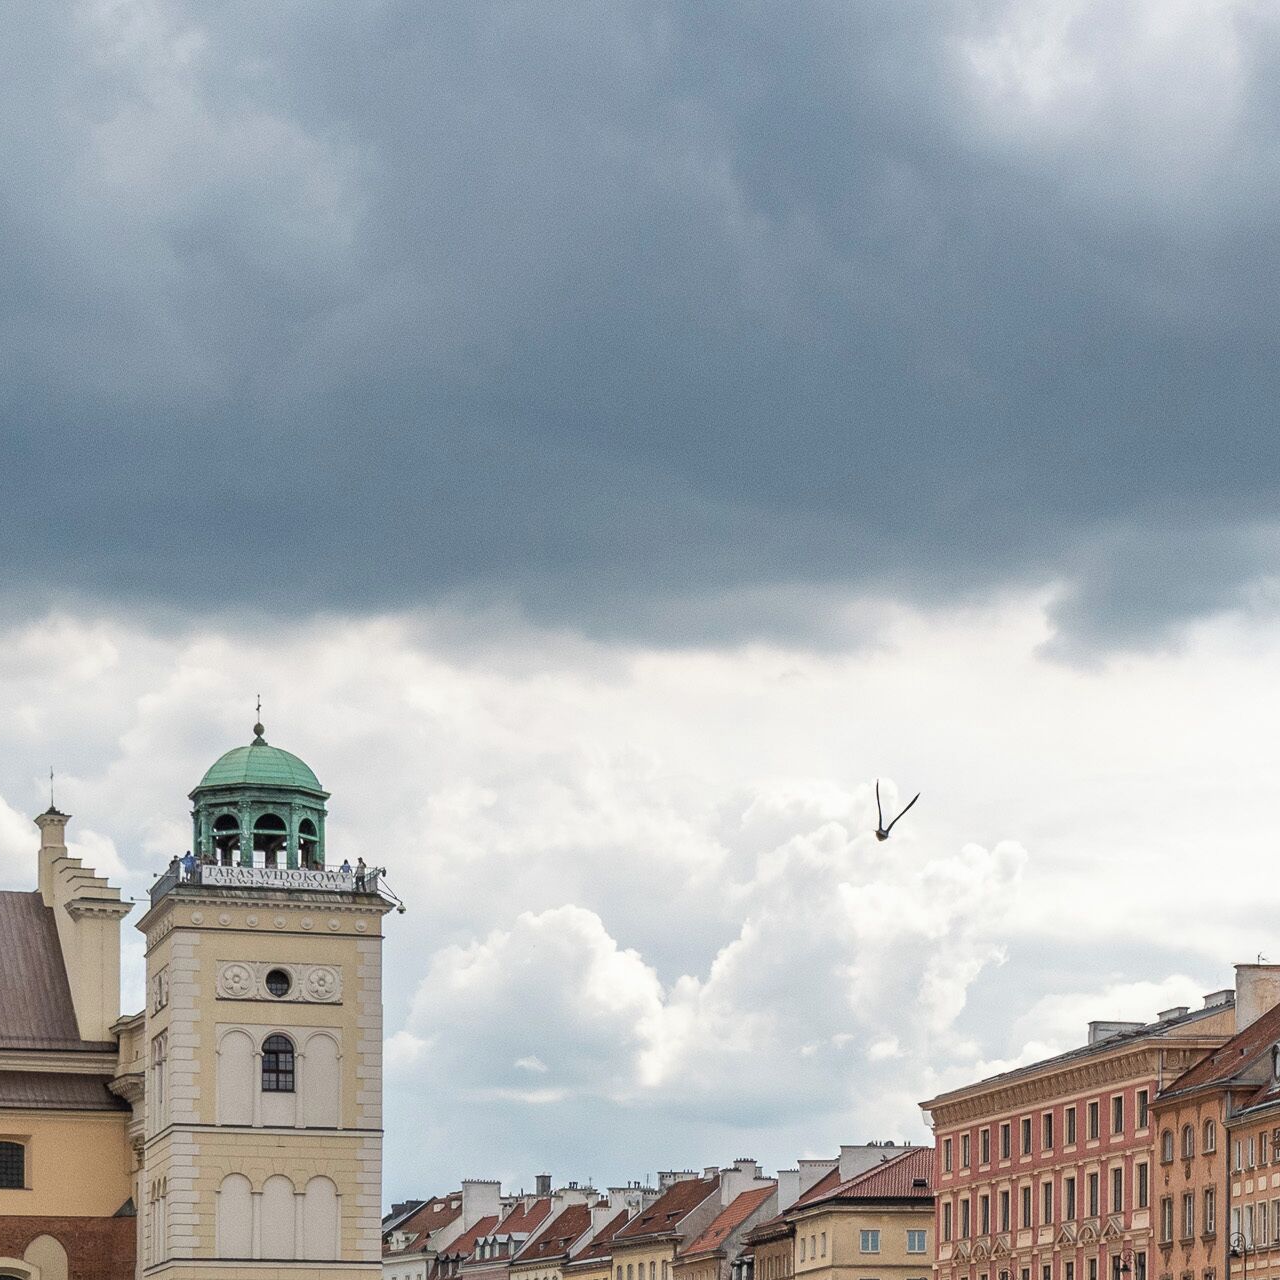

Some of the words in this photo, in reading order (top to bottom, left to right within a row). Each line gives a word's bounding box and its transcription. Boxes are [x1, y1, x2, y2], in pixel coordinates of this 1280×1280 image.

[205, 867, 254, 878] TARAS
[259, 870, 347, 883] WIDOKOWY
[282, 881, 343, 890] TERRACE
